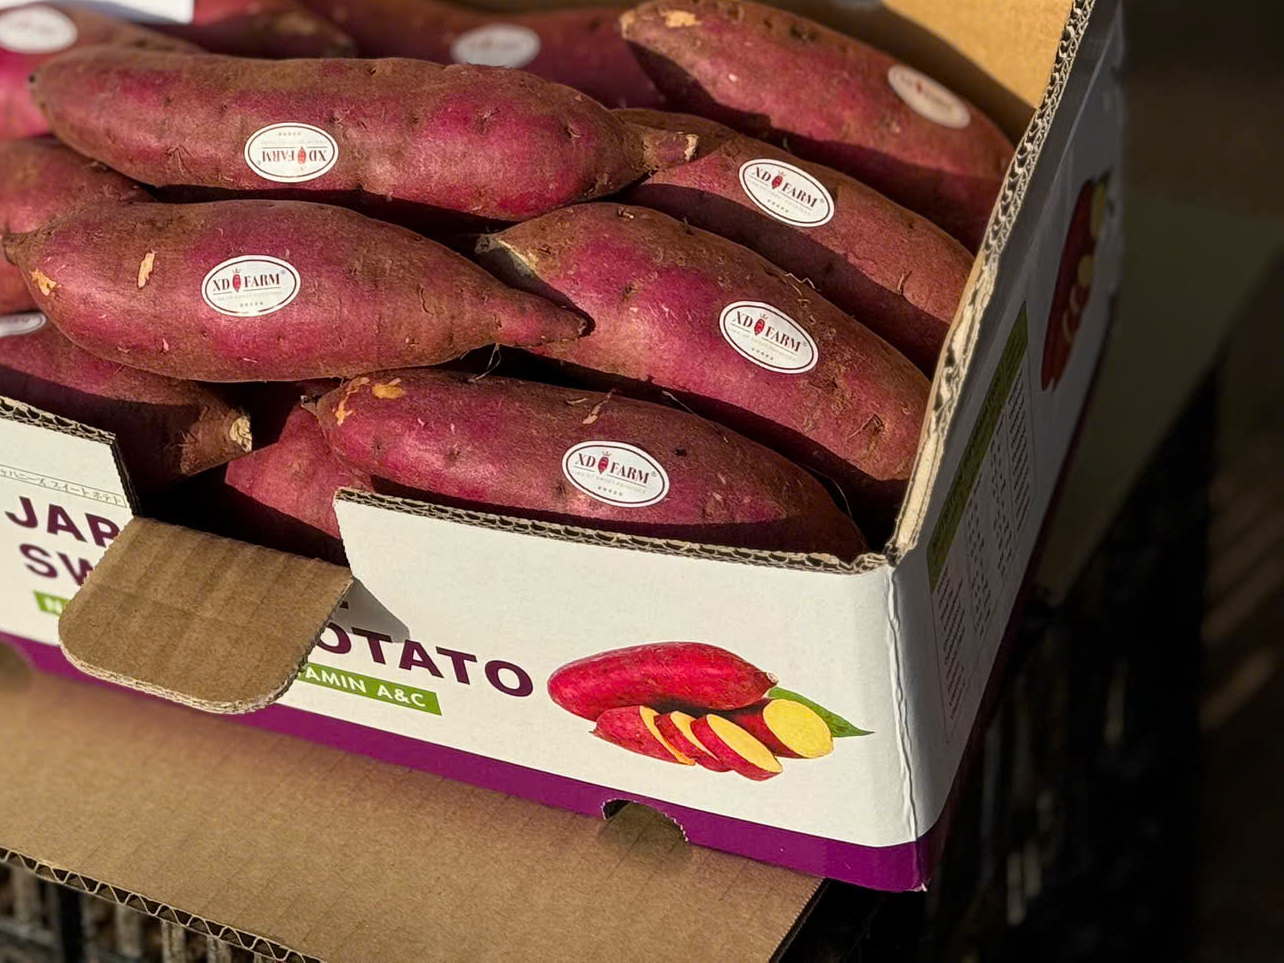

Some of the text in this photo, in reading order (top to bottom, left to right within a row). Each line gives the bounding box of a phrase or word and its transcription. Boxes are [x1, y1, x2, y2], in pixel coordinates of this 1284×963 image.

[261, 149, 328, 164] XD FARM
[751, 166, 772, 183] XD
[781, 182, 818, 209] FARM
[212, 272, 281, 292] XD FARM
[731, 310, 754, 329] XD
[765, 325, 802, 353] FARM
[574, 452, 597, 469] XD
[609, 461, 650, 485] FARM
[316, 620, 535, 698] OTATO
[376, 683, 427, 709] A&C
